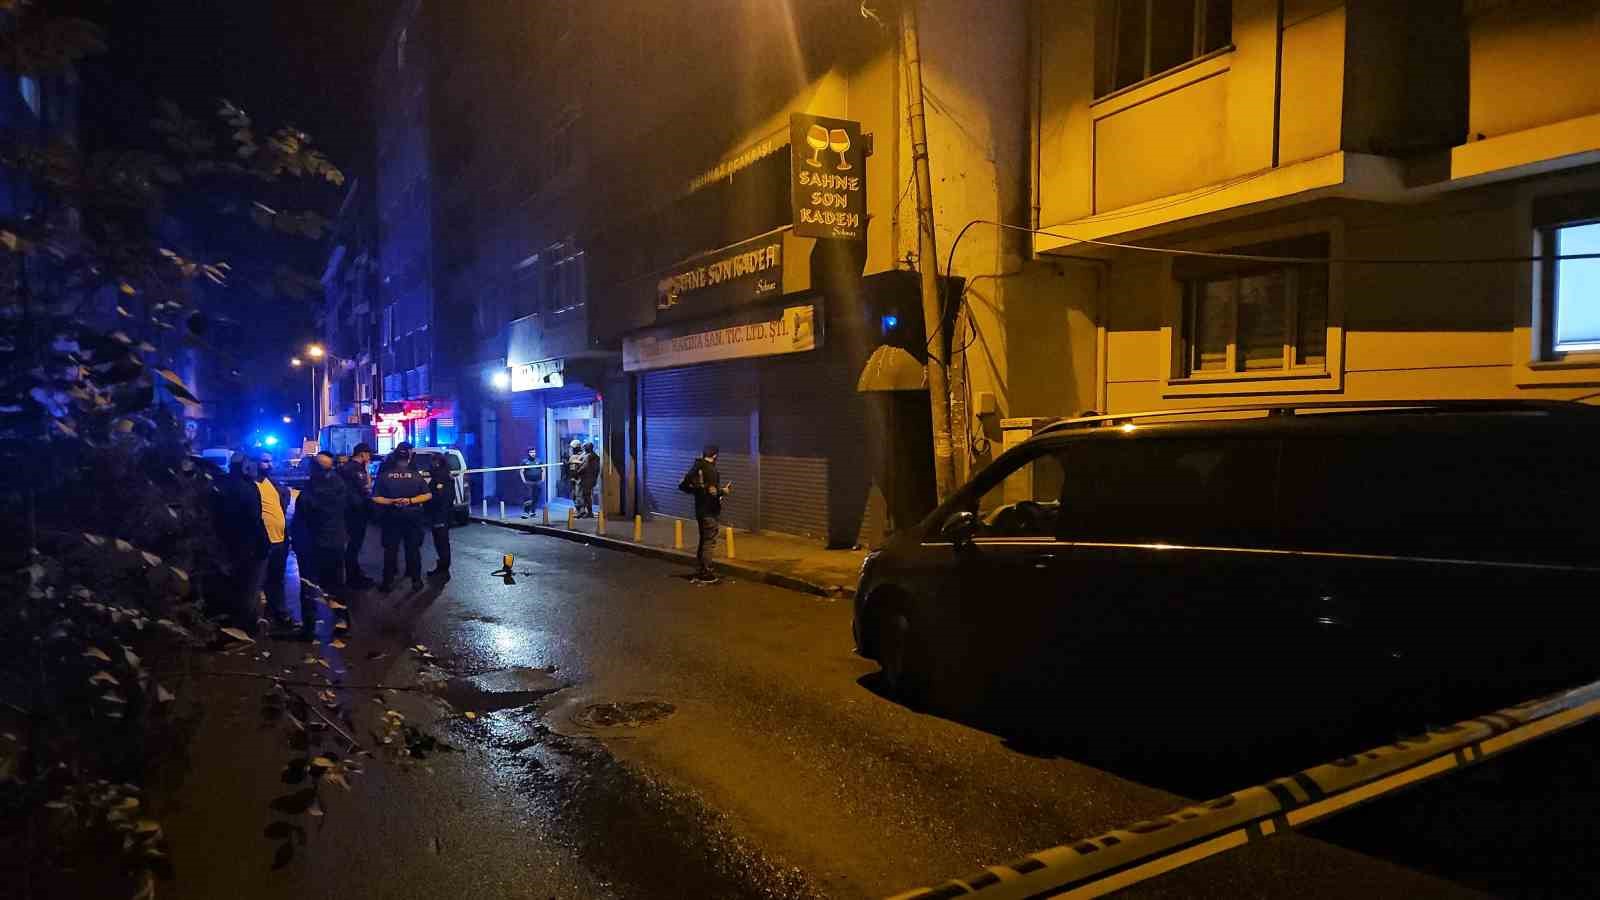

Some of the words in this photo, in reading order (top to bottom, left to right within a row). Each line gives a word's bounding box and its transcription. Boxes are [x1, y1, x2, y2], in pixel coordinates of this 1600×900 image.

[799, 170, 860, 191] SAHNE
[810, 191, 848, 208] SON
[799, 208, 859, 228] KADEH
